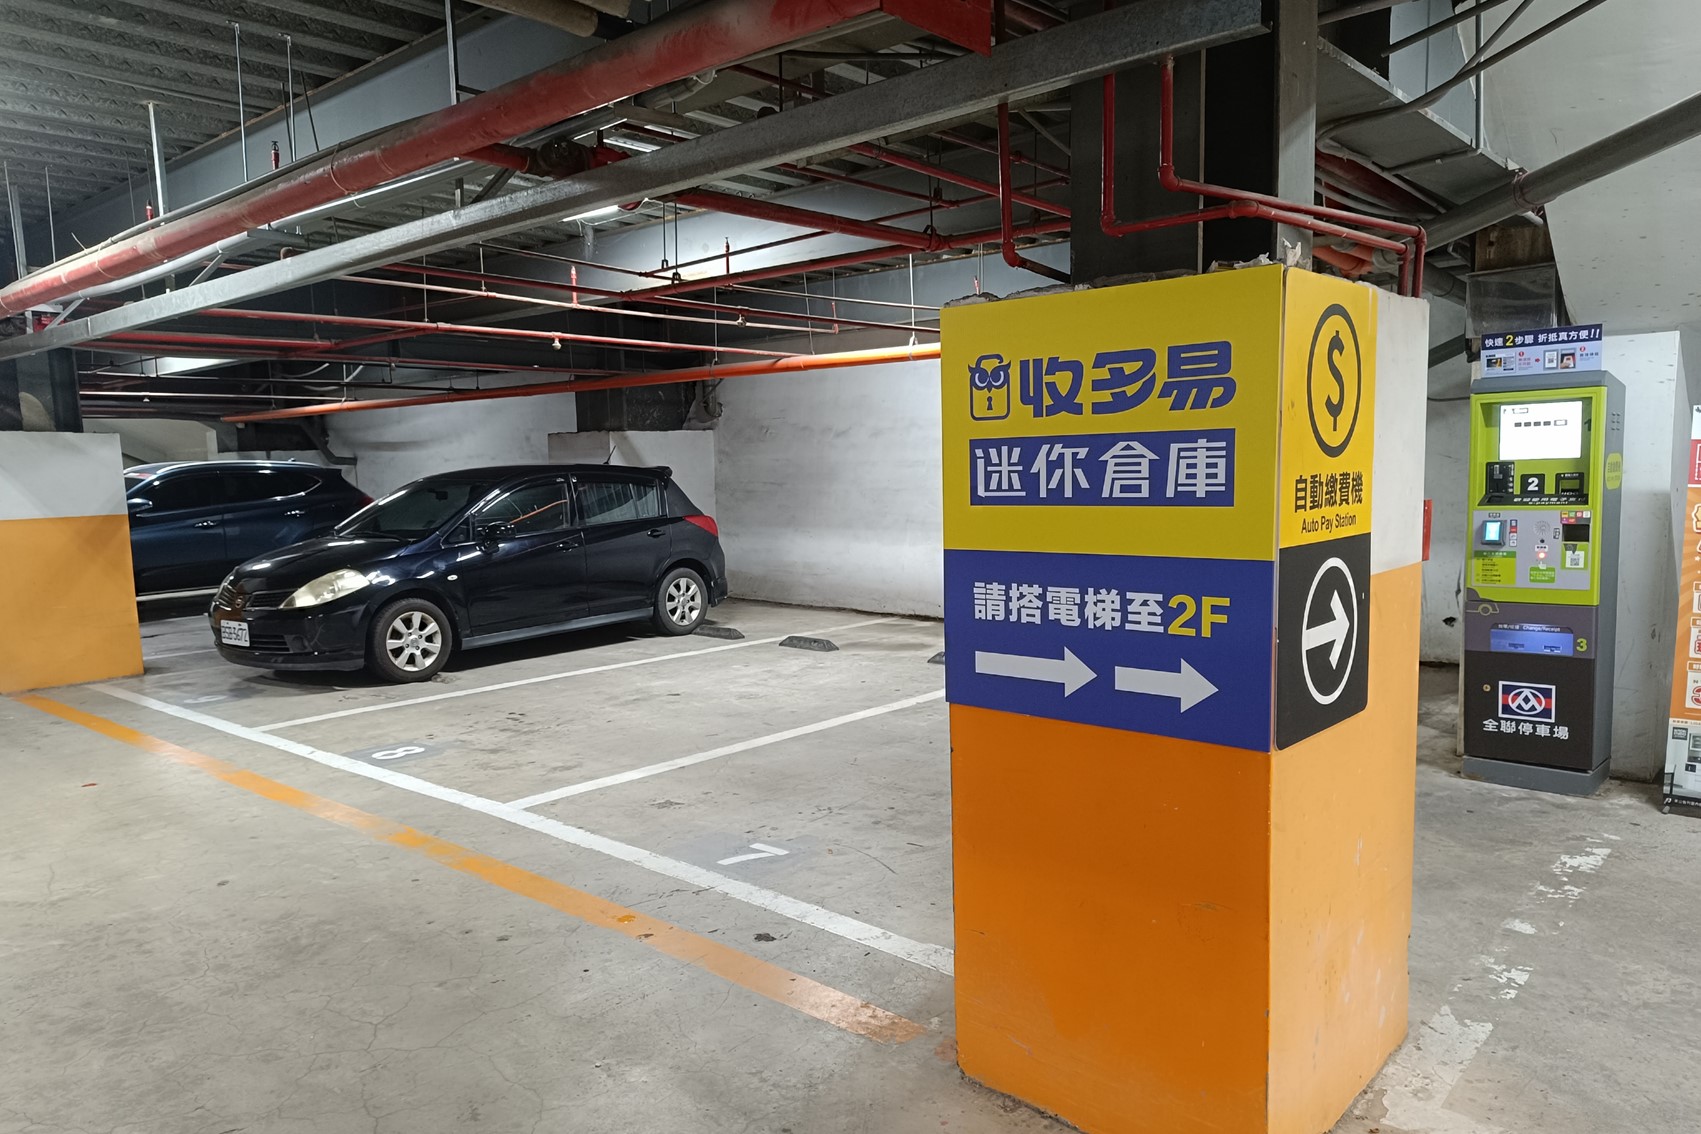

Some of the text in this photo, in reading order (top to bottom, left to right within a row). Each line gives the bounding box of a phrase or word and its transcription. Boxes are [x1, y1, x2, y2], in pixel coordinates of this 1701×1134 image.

[1019, 340, 1237, 418] 收多易
[974, 438, 1227, 499] 迷你倉庫
[1294, 470, 1364, 513] 自動繳費機
[1527, 477, 1539, 491] 2
[1301, 512, 1357, 533] Auto Pay Station
[973, 581, 1230, 638] 請搭電梯至2F
[1576, 638, 1588, 652] 3
[1482, 718, 1569, 740] 全聯停車場
[371, 746, 425, 760] 8
[716, 842, 790, 866] 7
